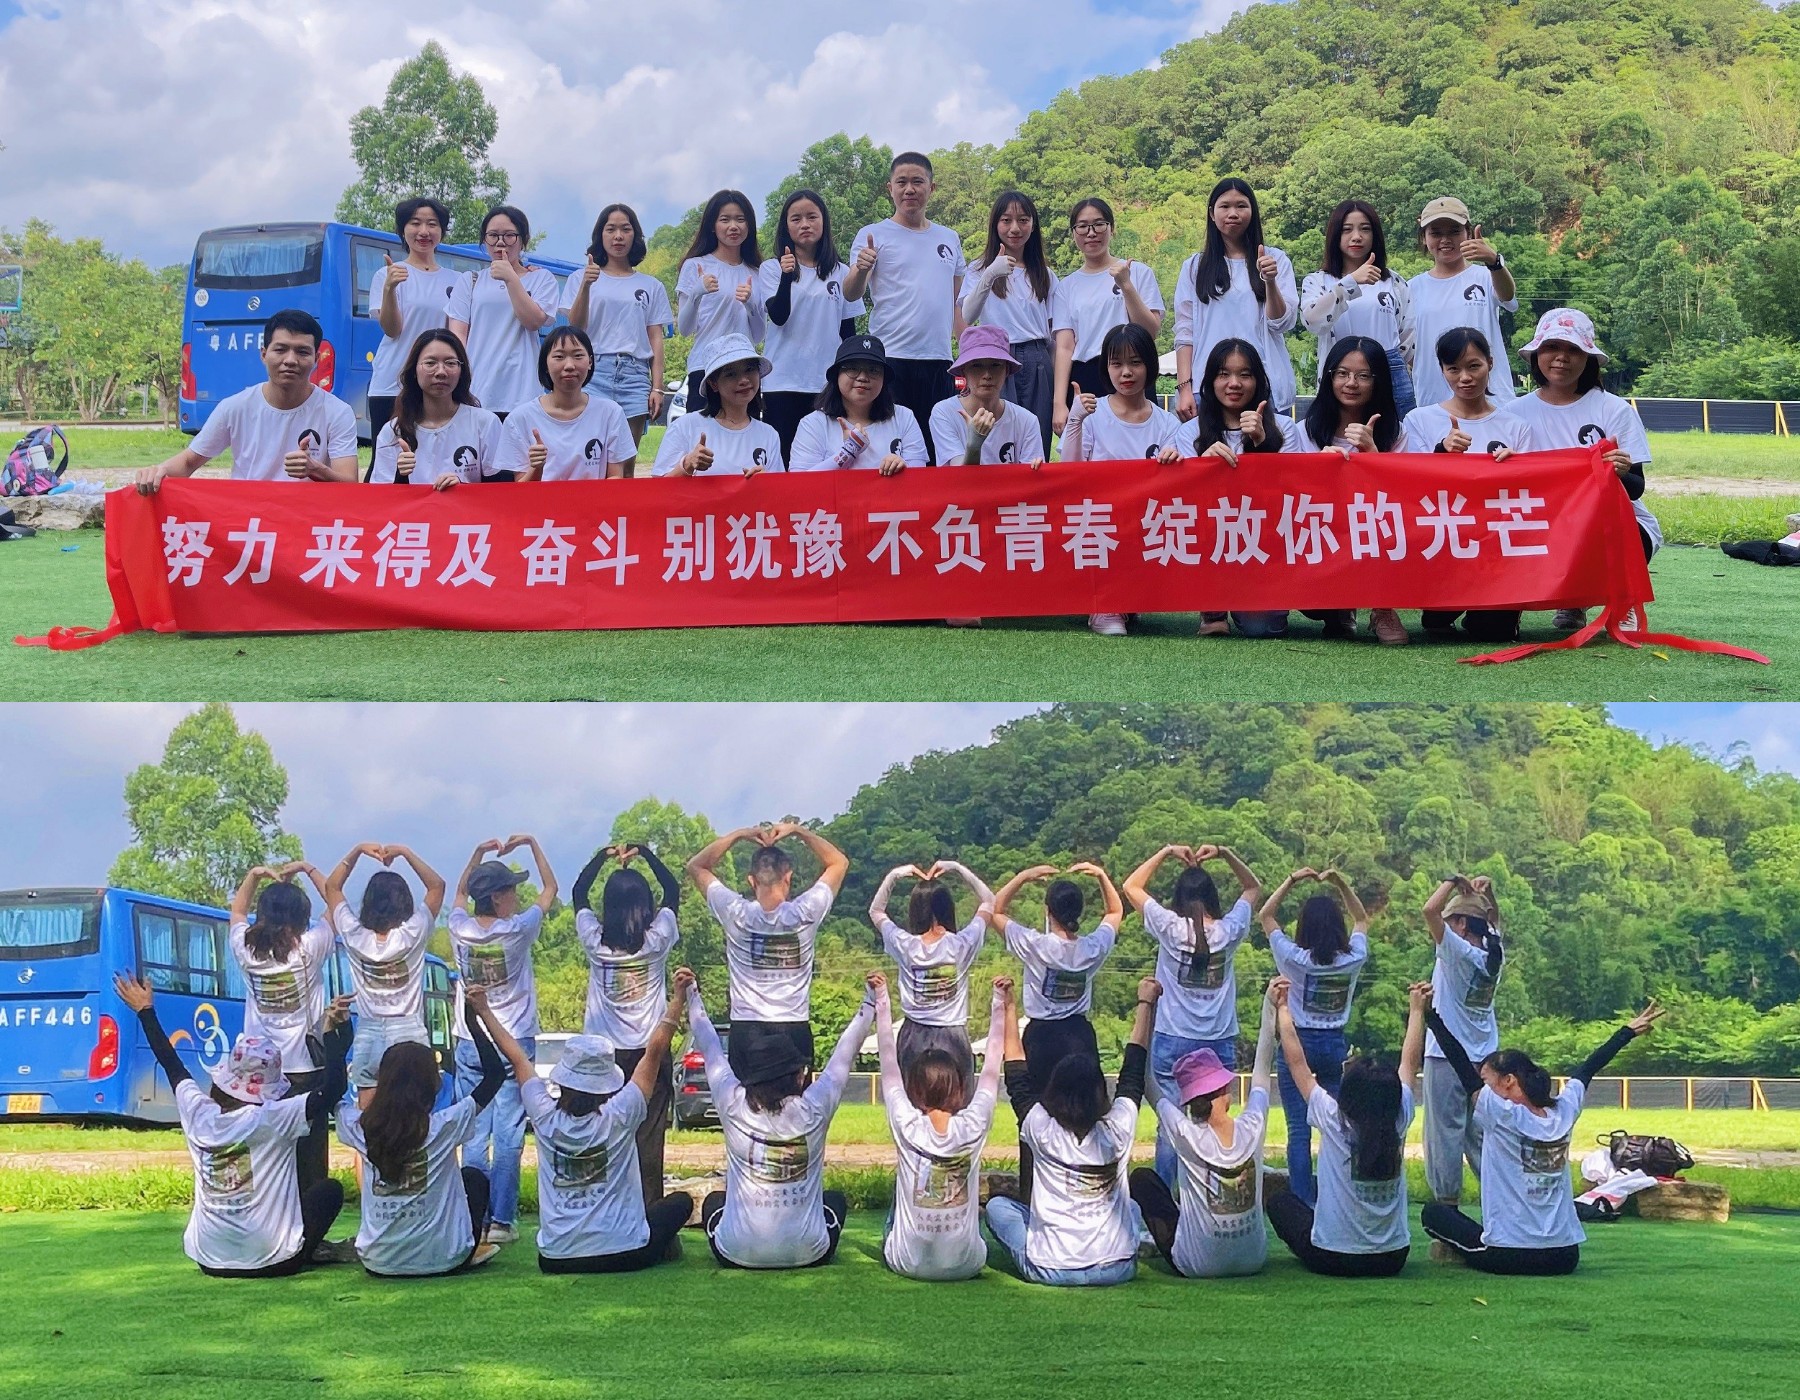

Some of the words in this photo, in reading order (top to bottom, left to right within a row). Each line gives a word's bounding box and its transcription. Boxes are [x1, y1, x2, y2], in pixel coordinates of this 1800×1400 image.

[161, 515, 277, 587] 努力
[299, 519, 497, 588] 来得及
[520, 518, 640, 586] 奋斗
[661, 508, 847, 583] 别犹豫
[866, 498, 1120, 575] 不负青春
[1140, 489, 1550, 567] 绽放你的光芒
